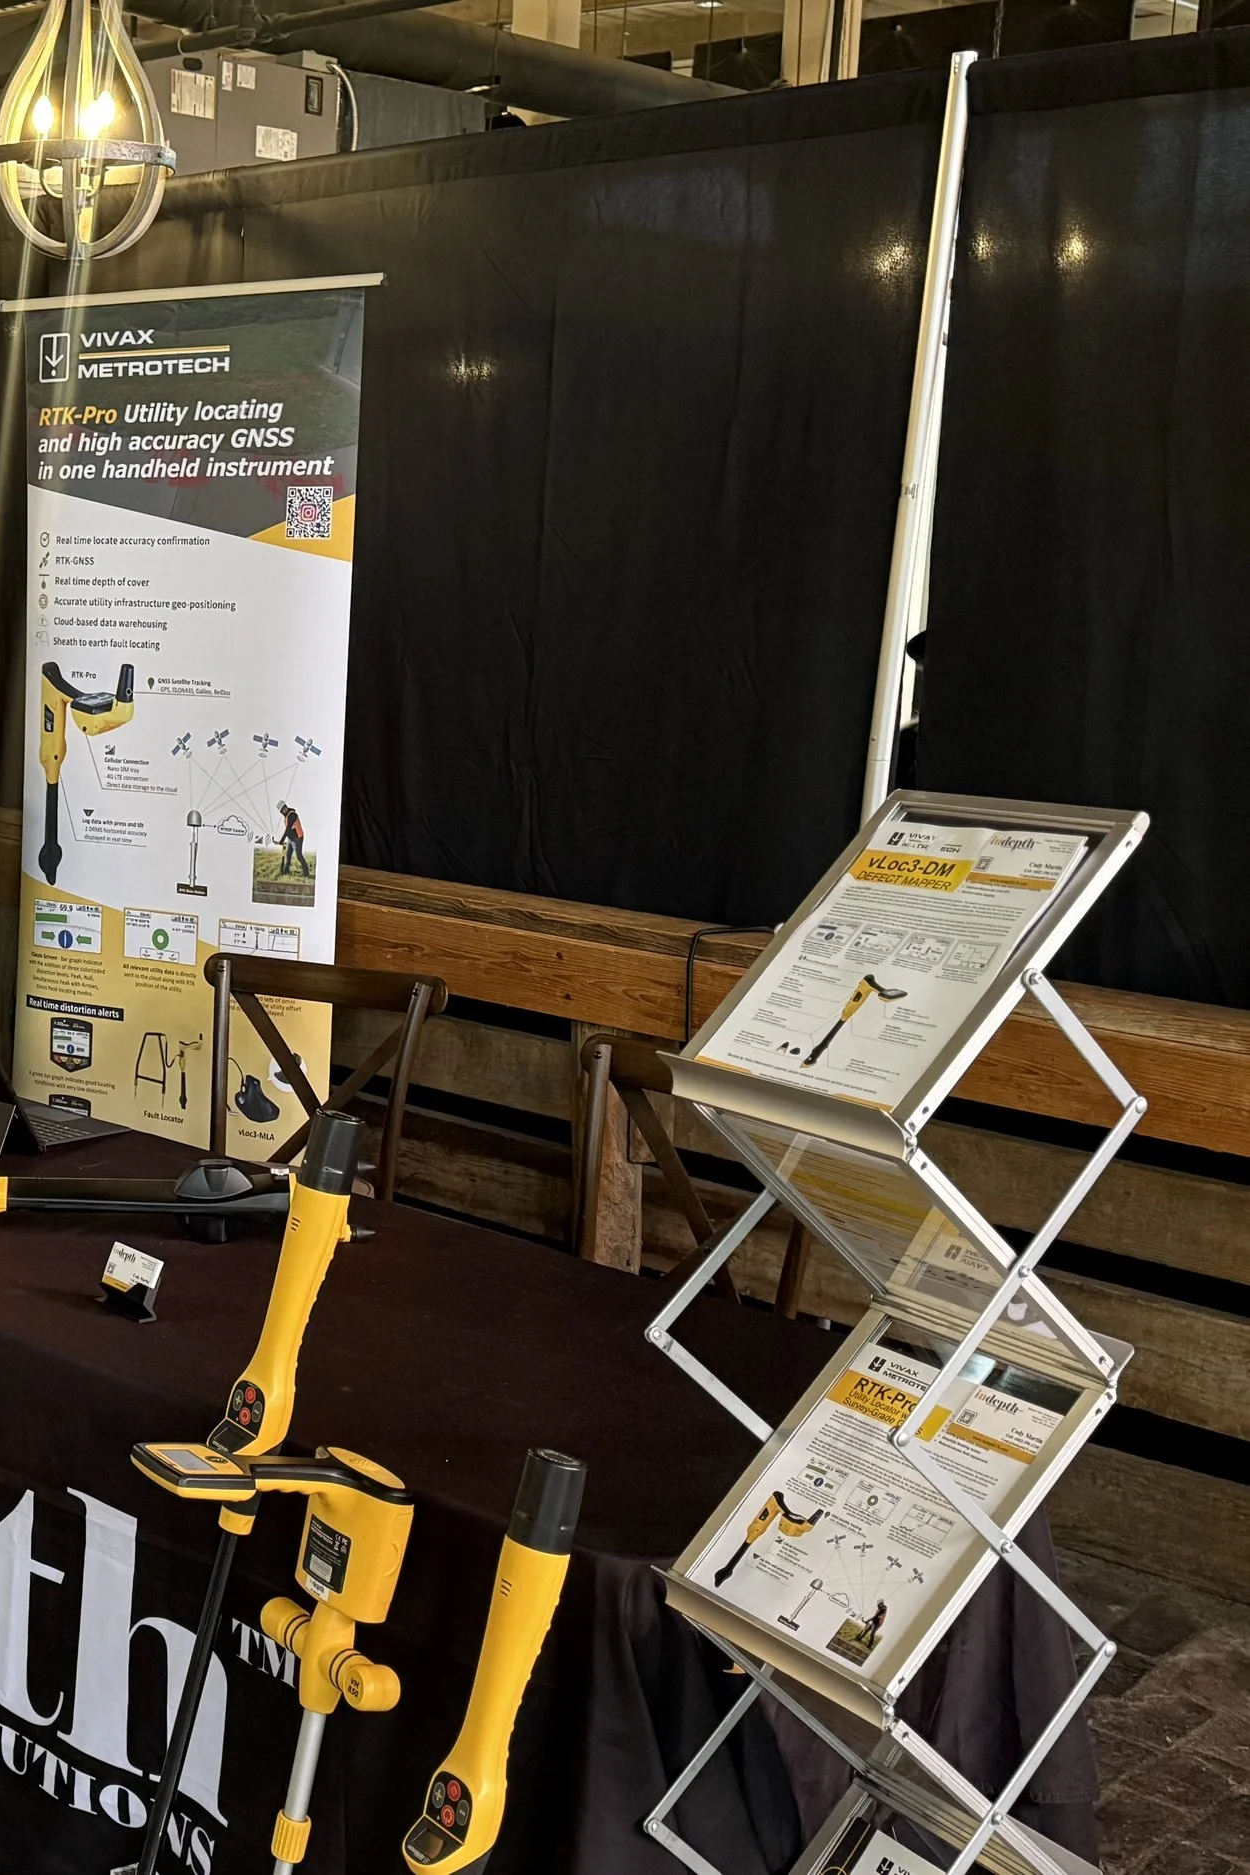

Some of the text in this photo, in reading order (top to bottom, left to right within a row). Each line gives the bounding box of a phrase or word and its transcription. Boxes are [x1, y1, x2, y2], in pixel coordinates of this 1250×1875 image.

[80, 329, 154, 348] VIVAX
[78, 357, 230, 379] METROTECH
[39, 399, 283, 426] RTK-Pro Utility locating
[38, 427, 295, 456] and high accuracy GNSS
[38, 456, 334, 480] in one handheld instrument
[56, 536, 210, 547] Real time locate accuracy confirmation
[55, 556, 94, 565] RTK-GNSS
[55, 577, 150, 587] Real time depth of cover
[54, 597, 236, 611] Accurate utility infrastructure geo-positioning
[53, 617, 167, 630] Cloud-based data warehousing
[53, 637, 160, 651] Sheath to earth fault locating
[71, 671, 96, 679] RTK-Pro
[990, 836, 1035, 851] indepth
[868, 856, 956, 877] vLoc3-DM
[857, 870, 952, 890] DEFECT MAPPER
[29, 997, 119, 1018] Real time distortion alerts
[143, 1110, 184, 1125] Fault Locator
[890, 1362, 919, 1377] VIVAX
[882, 1370, 929, 1392] METROTE
[842, 1396, 895, 1424] Survey-Grade
[870, 1400, 901, 1416] Locator
[974, 1389, 1020, 1413] indepth
[232, 1618, 297, 1688] TM
